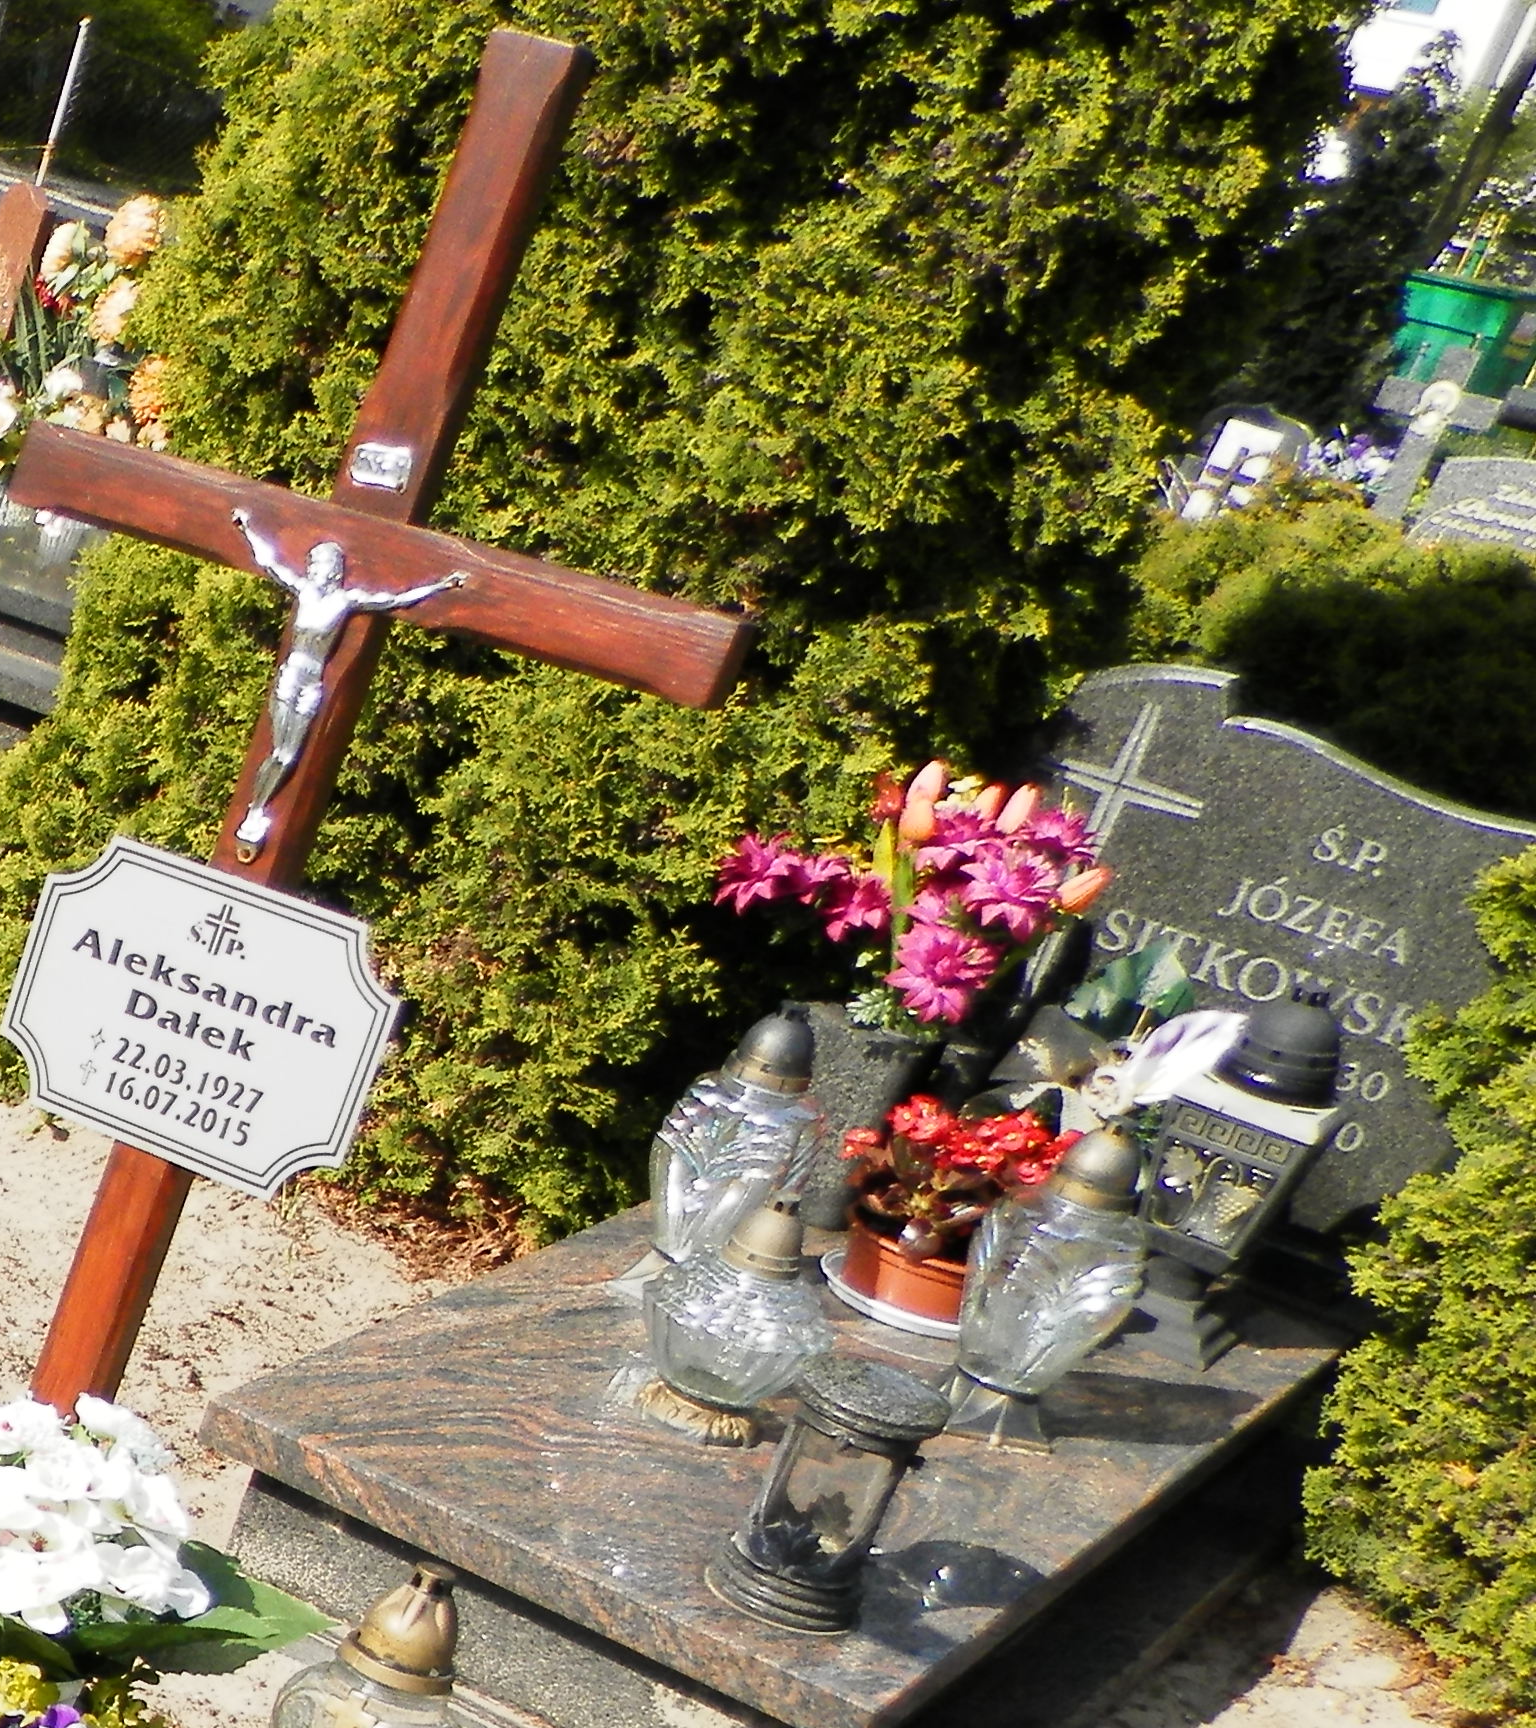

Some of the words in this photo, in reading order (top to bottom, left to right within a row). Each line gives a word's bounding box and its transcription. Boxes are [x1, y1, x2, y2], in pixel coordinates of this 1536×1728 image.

[1218, 876, 1408, 966] JÓZEFA
[71, 928, 337, 1049] Aleksandra
[124, 988, 257, 1062] Dałek
[104, 1071, 251, 1147] 16.07.2015
[112, 1037, 264, 1114] 22.03.1927
